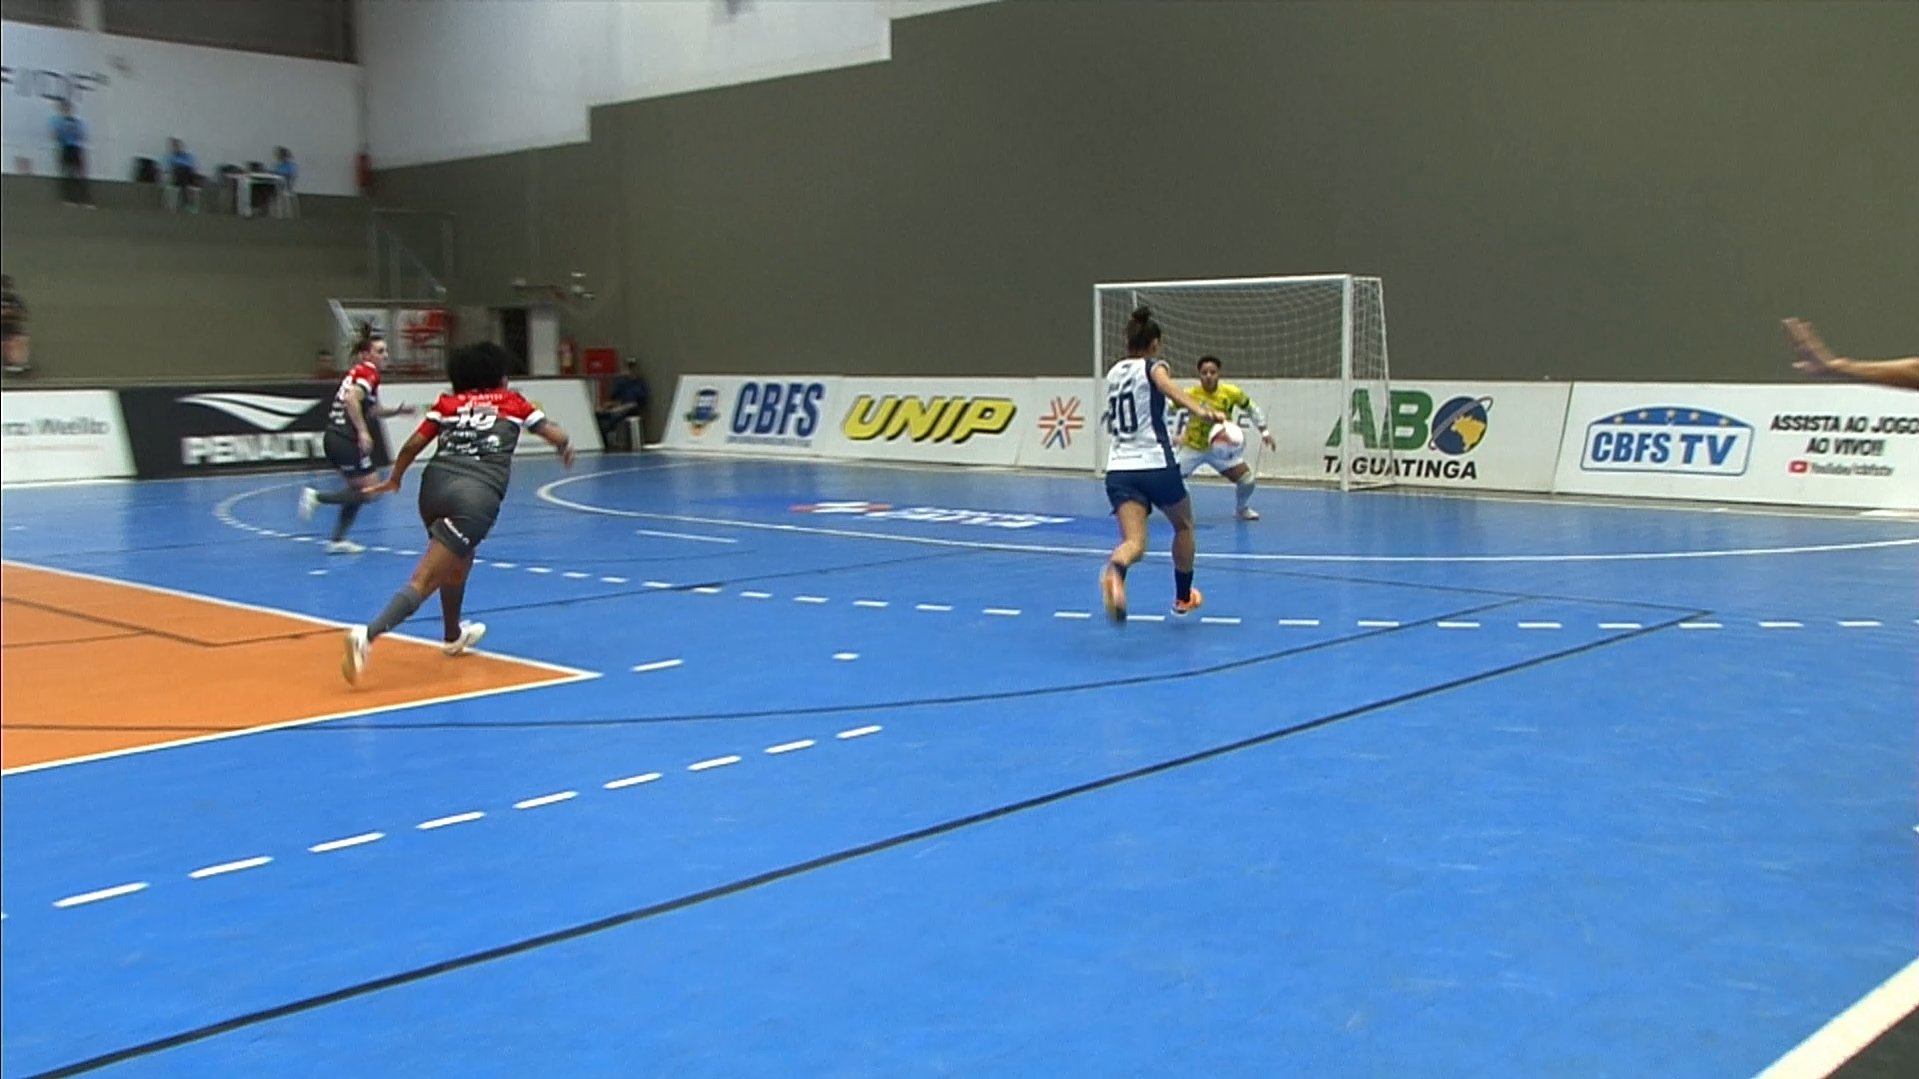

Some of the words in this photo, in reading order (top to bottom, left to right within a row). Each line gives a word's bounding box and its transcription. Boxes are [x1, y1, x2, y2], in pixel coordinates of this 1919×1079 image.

[733, 382, 825, 437] CBFS
[842, 395, 1017, 444] UNIP
[1770, 415, 1840, 431] ASSISTA
[1844, 416, 1868, 432] AO
[1591, 431, 1671, 464] CBFS
[1679, 433, 1738, 466] TV
[1806, 438, 1830, 454] AO
